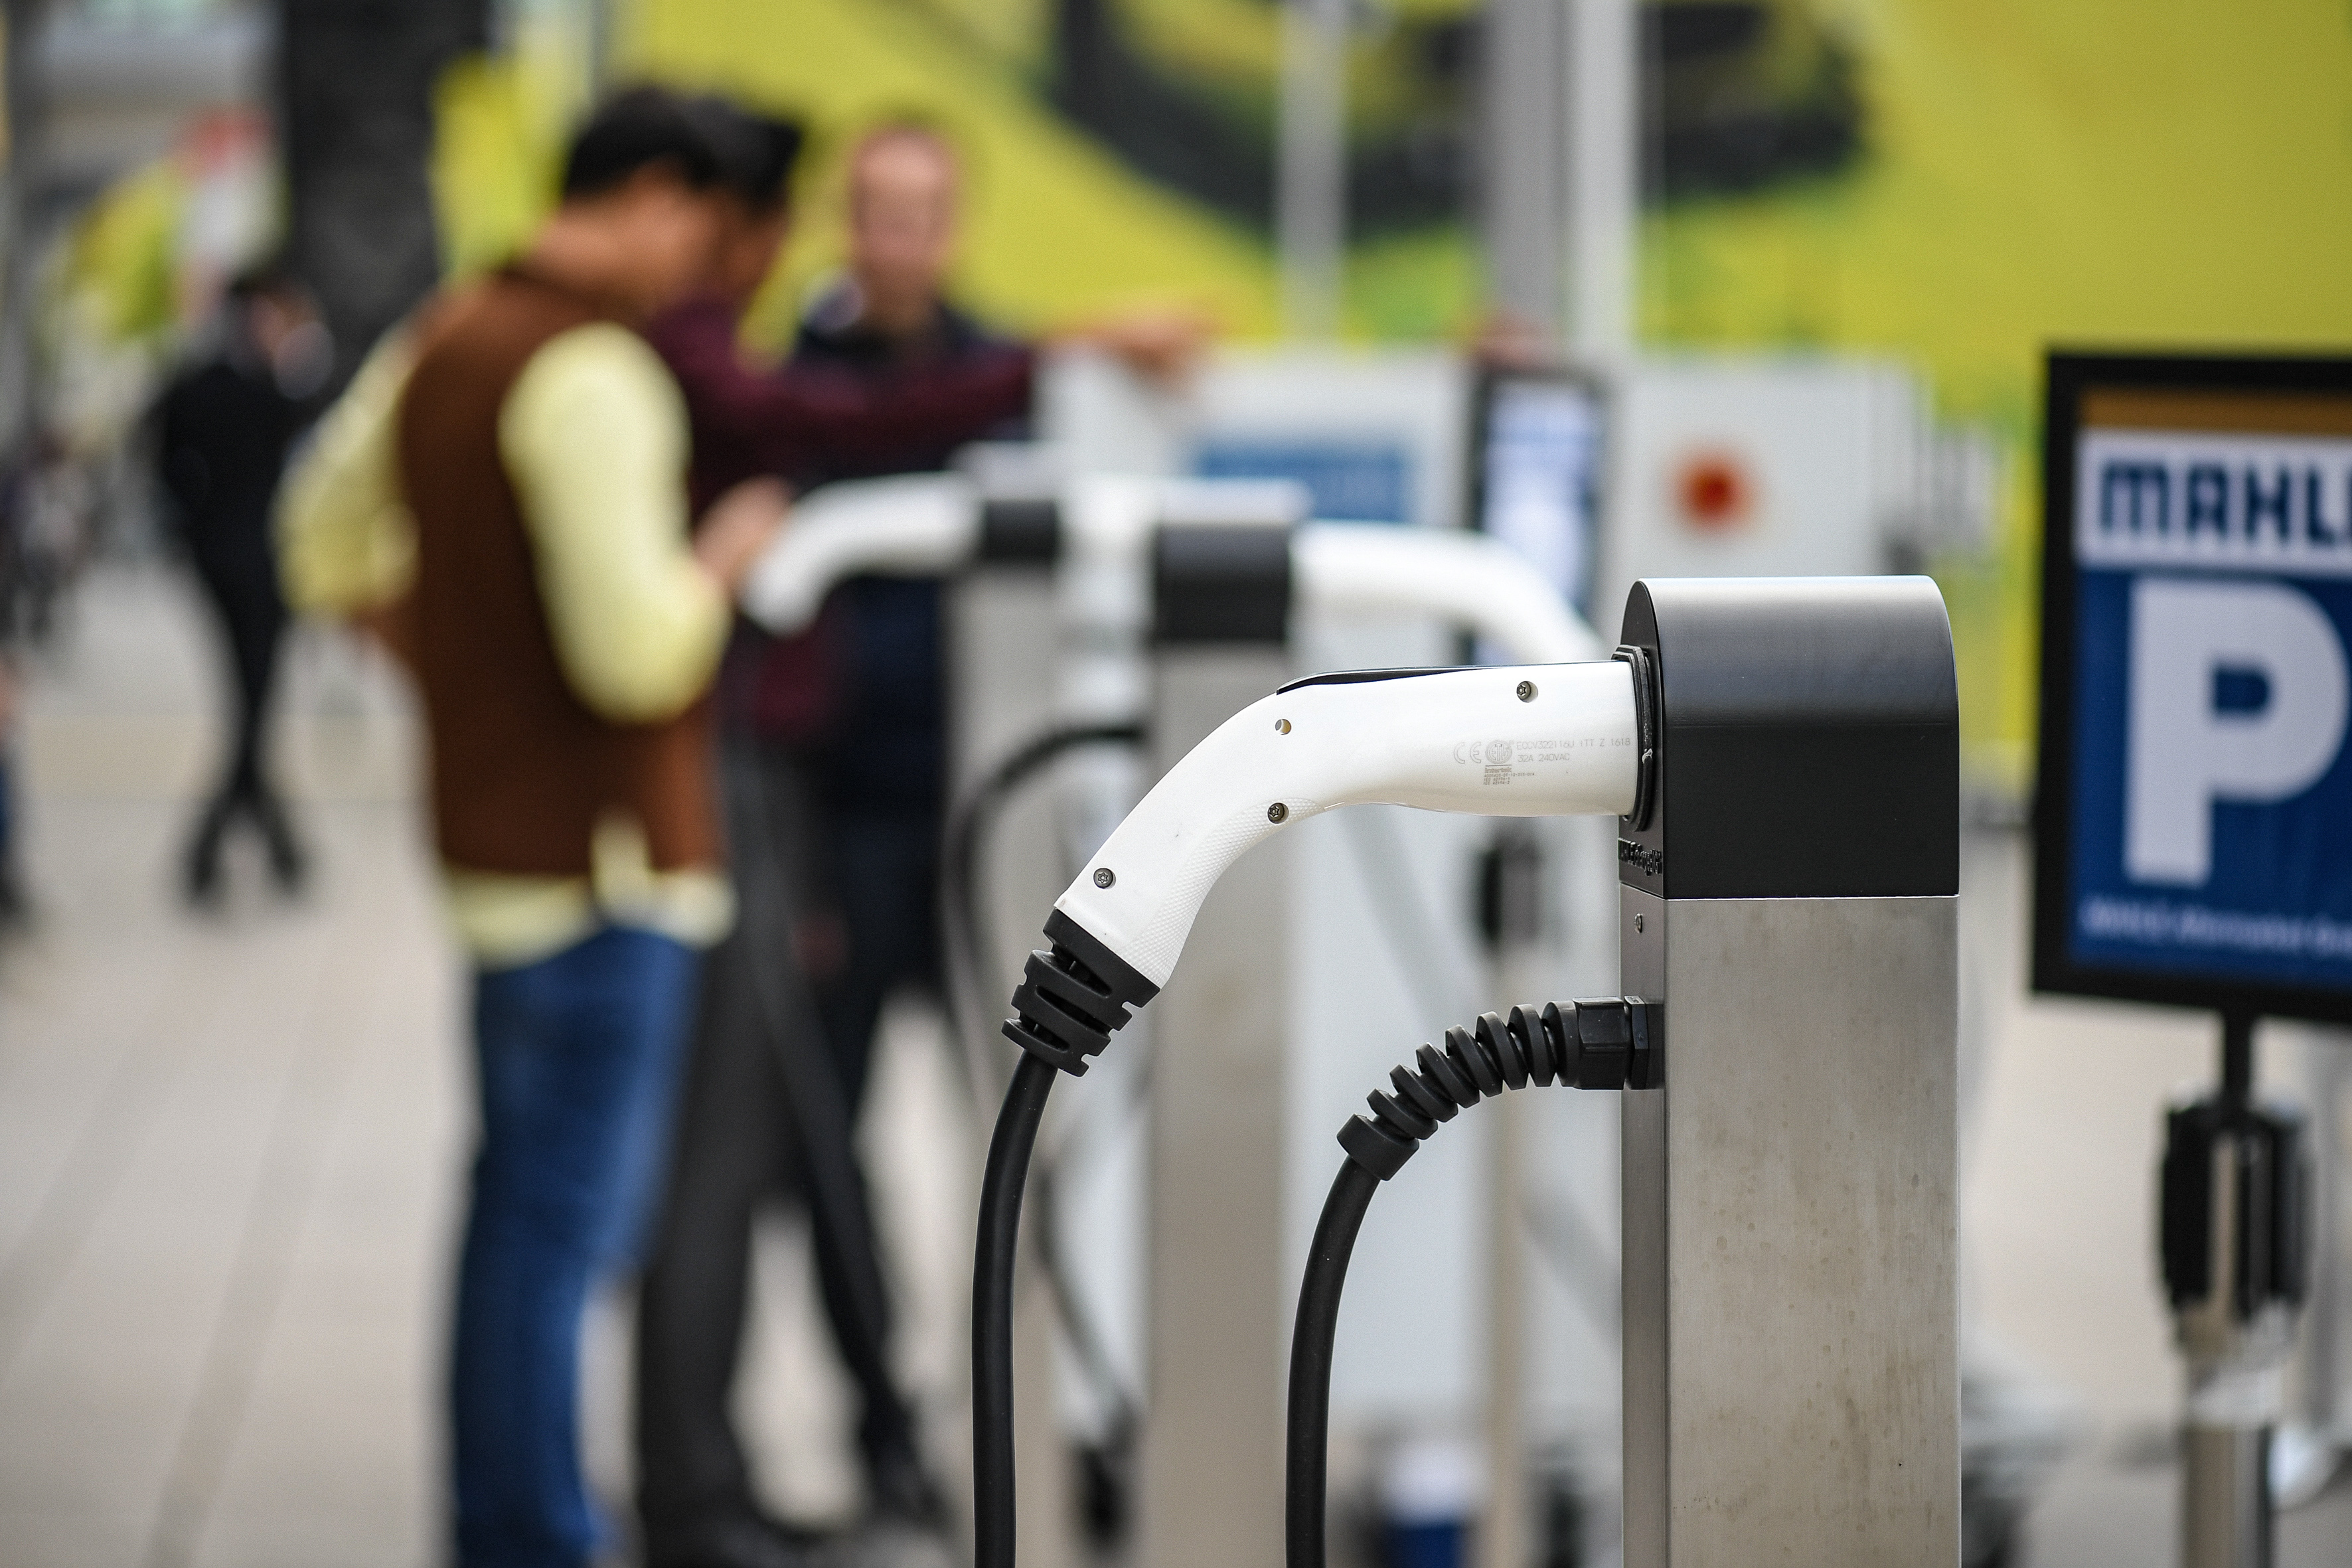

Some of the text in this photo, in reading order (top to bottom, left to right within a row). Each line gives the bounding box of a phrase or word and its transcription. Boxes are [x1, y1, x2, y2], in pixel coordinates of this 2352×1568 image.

[2098, 459, 2352, 546] MAHL
[1518, 753, 1571, 763] 32A 240VAC
[2124, 576, 2350, 888] P
